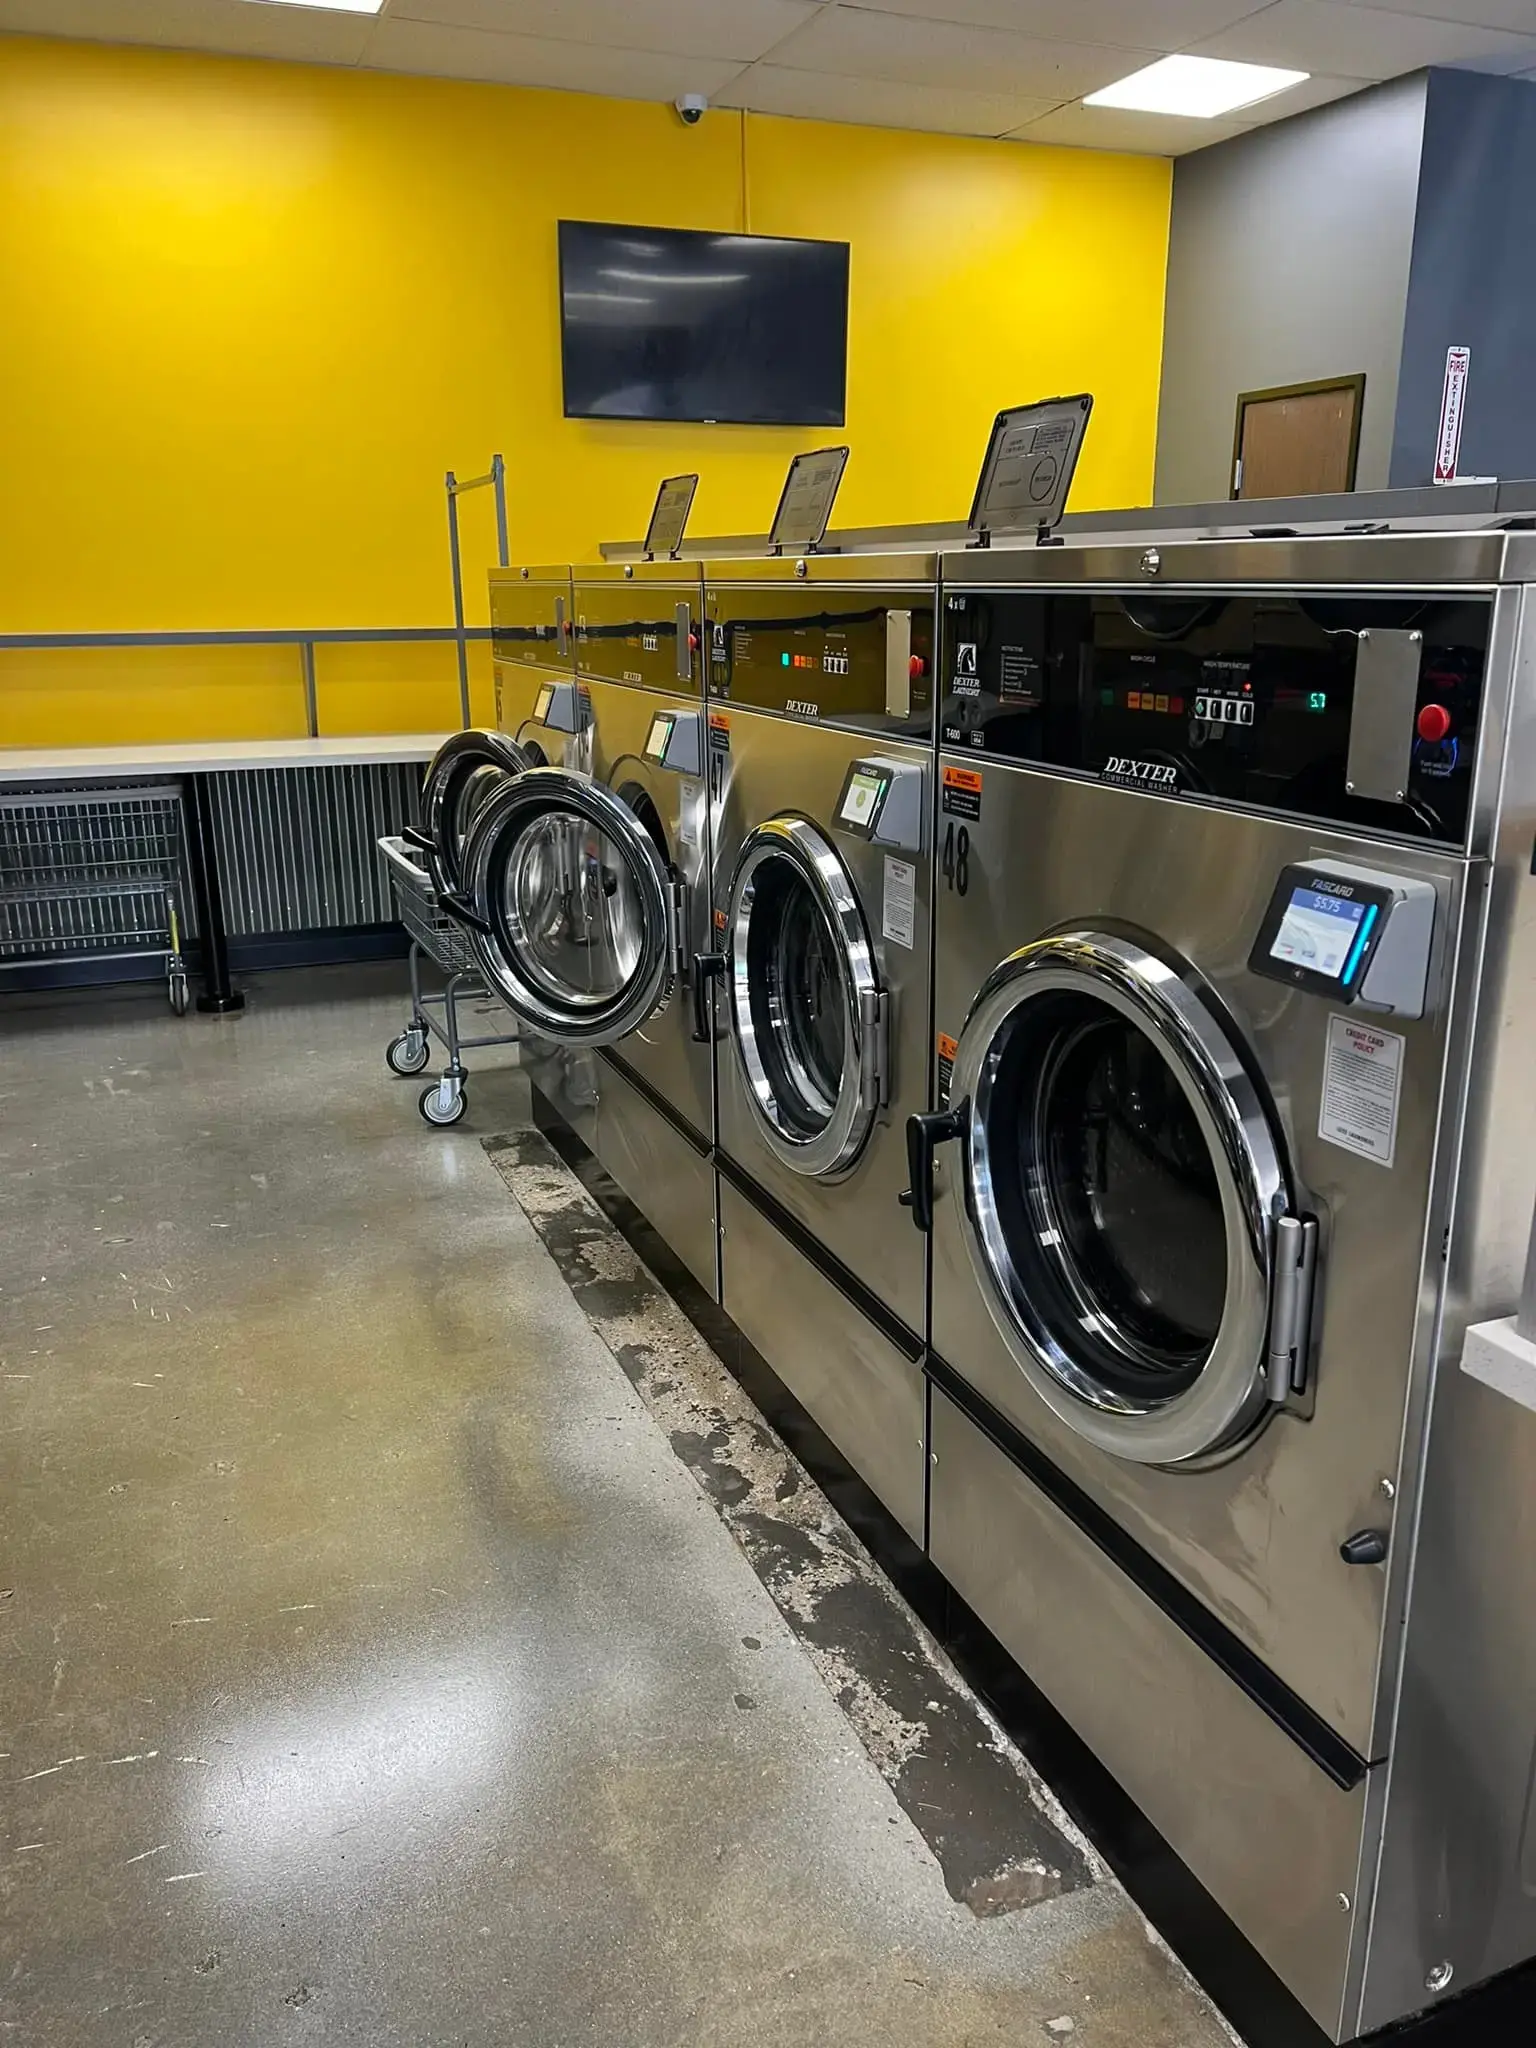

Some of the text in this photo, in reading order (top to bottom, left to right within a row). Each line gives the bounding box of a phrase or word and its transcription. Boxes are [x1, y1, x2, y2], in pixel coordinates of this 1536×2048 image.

[1449, 360, 1466, 373] FIRE
[1443, 374, 1459, 472] EXTINGUISHER
[953, 676, 980, 688] DEXTER
[785, 700, 818, 716] DEXTER
[1310, 693, 1326, 709] 57
[1104, 757, 1177, 784] DEXTER
[1101, 772, 1178, 794] COMMERCIAL WASHER
[942, 822, 970, 897] 48
[1311, 879, 1355, 898] FASCARD
[1313, 896, 1341, 913] $5.75
